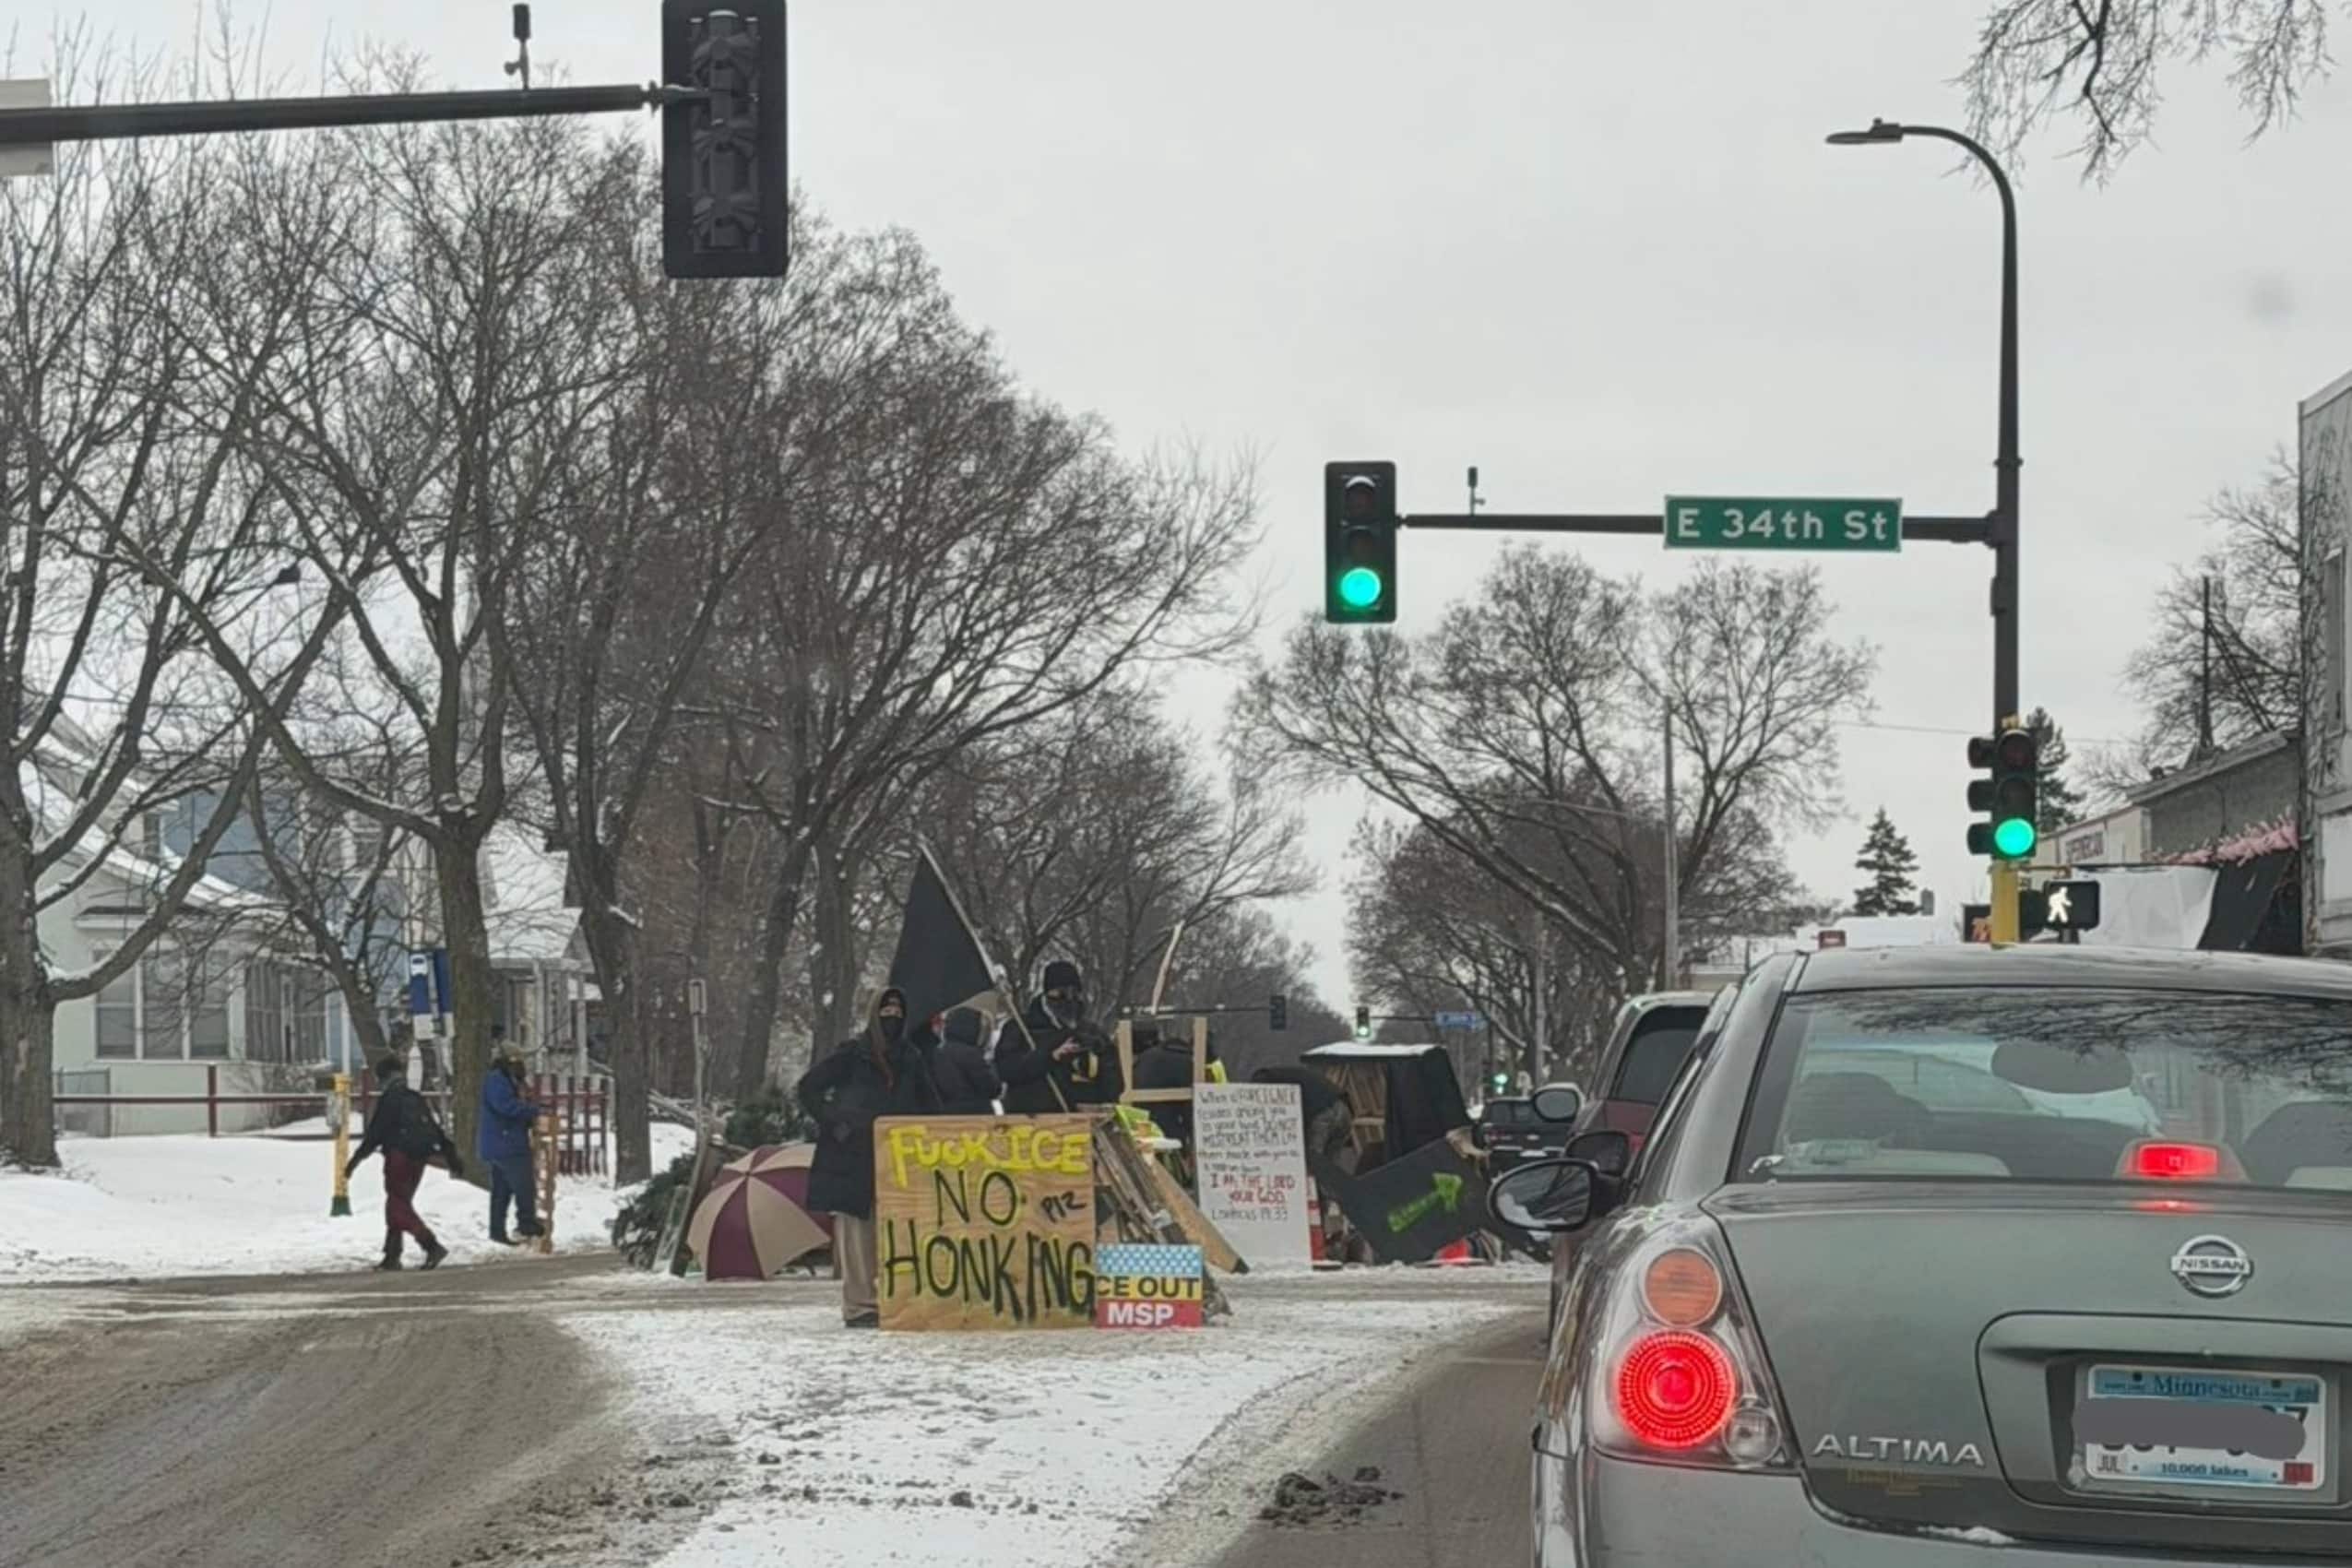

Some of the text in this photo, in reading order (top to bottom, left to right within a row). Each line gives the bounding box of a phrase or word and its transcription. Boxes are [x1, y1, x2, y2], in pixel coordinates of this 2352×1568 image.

[1677, 508, 1888, 540] E 34th St
[1000, 1124, 1091, 1173] ICE
[1210, 1172, 1218, 1189] I
[1241, 1172, 1261, 1188] THE
[1266, 1173, 1296, 1190] LORD
[1257, 1185, 1286, 1204] GOD
[885, 1218, 1096, 1322] HONKING
[2180, 1258, 2244, 1271] NISSAN
[1096, 1276, 1199, 1299] CE OUT
[1108, 1301, 1174, 1326] MSP
[2155, 1373, 2261, 1399] Minnesota
[1812, 1433, 1985, 1467] ALTIMA
